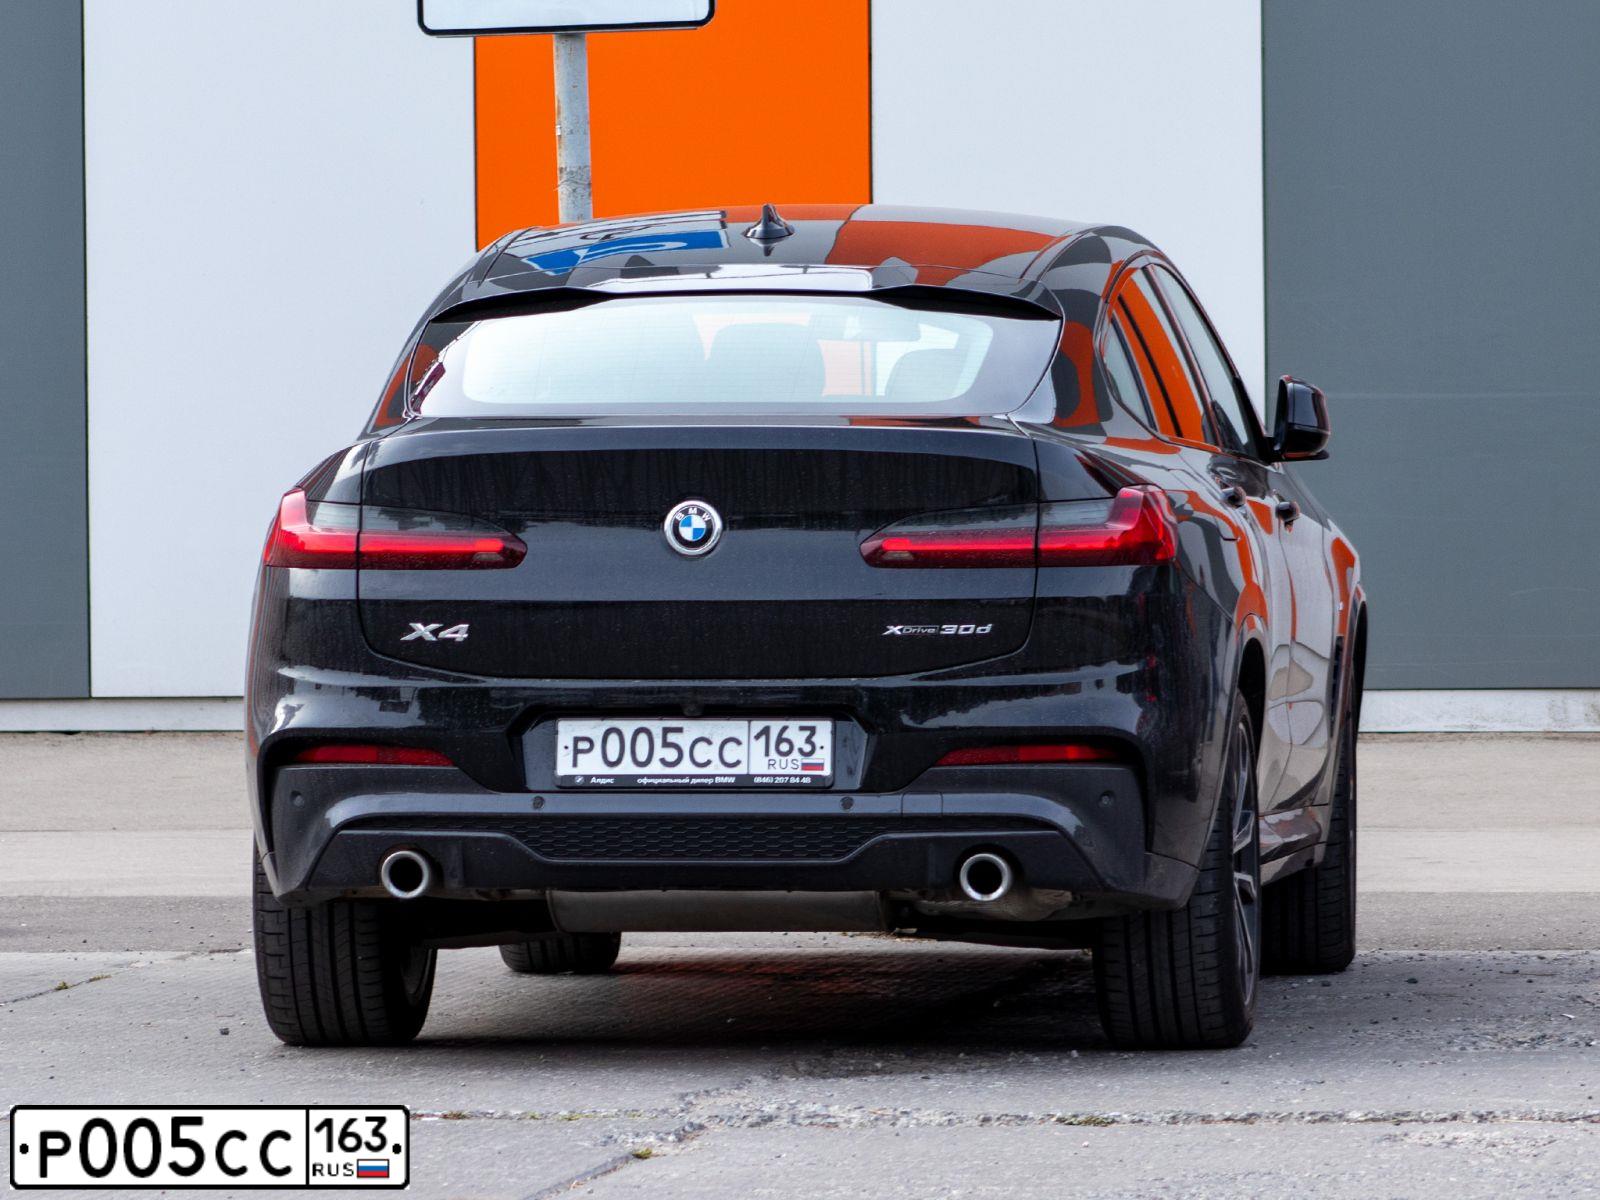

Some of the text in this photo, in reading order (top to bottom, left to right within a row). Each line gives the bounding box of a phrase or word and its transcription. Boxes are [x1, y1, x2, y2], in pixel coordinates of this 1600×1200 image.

[675, 507, 711, 521] BMW
[400, 622, 470, 641] X4
[753, 725, 818, 757] 163
[768, 759, 800, 770] RUS
[714, 776, 736, 784] BMW
